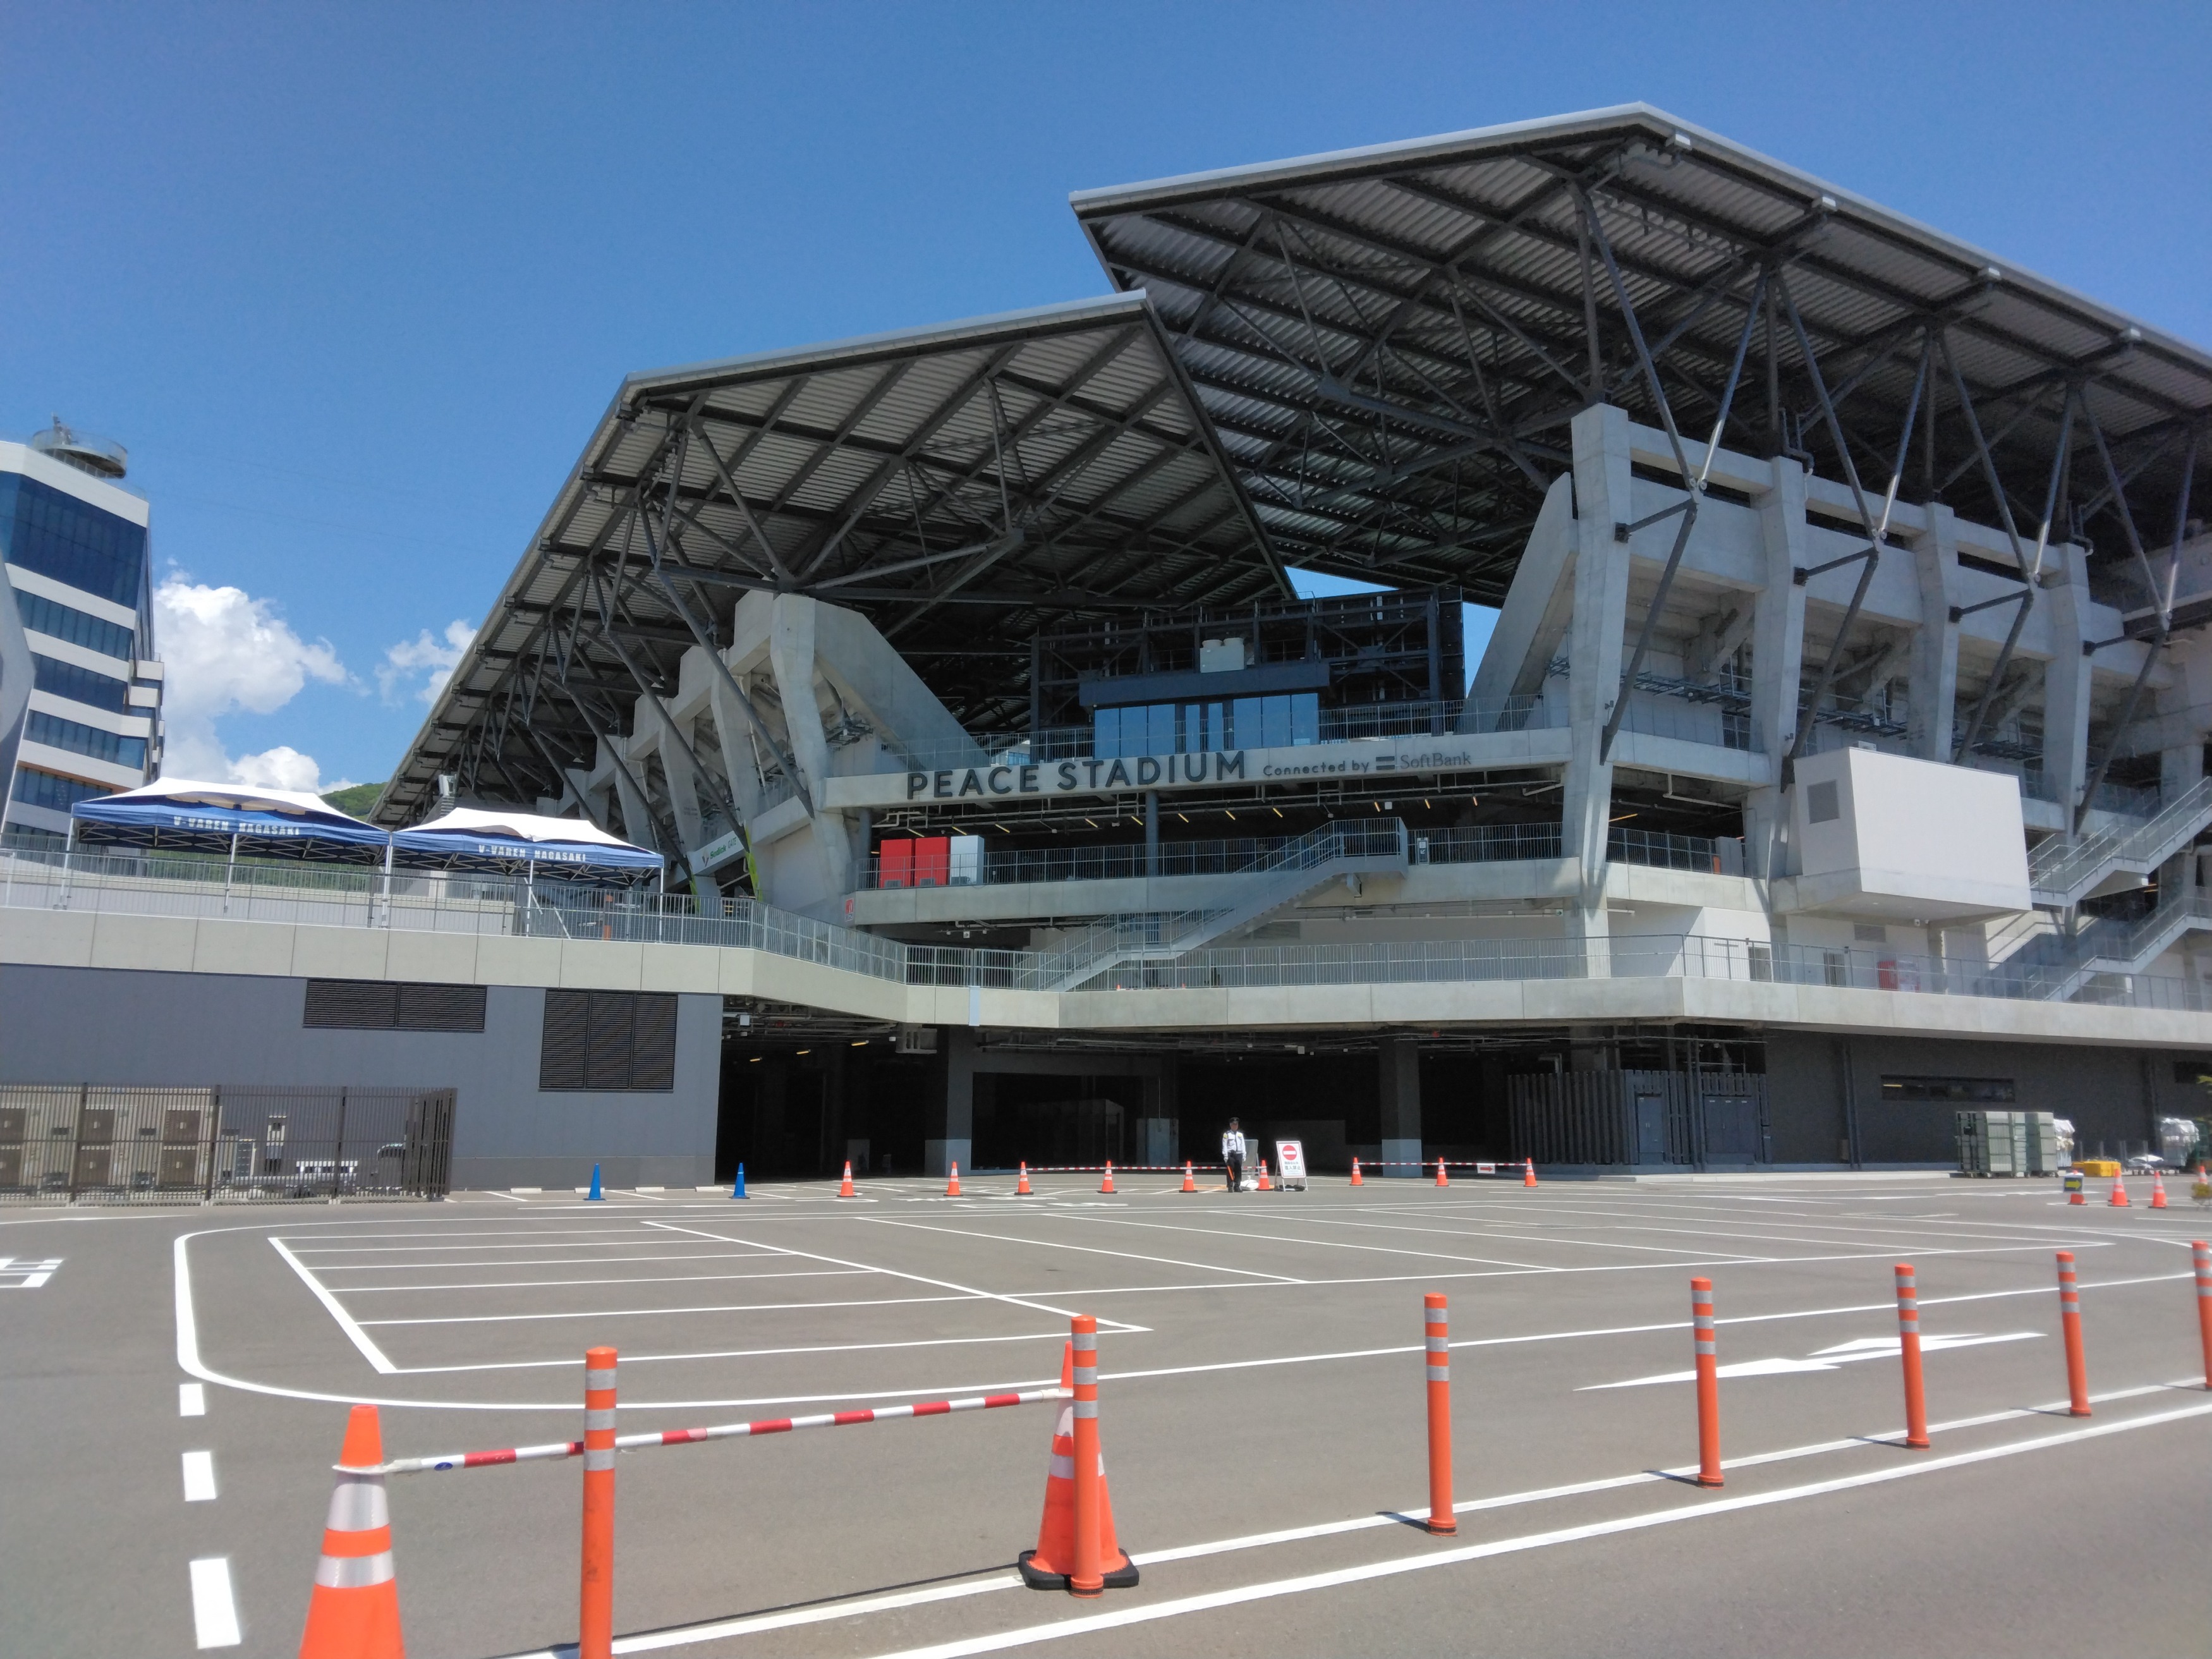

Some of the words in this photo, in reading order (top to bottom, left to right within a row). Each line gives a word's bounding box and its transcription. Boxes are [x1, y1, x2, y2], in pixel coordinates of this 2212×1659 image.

[907, 765, 1039, 799] PEACE
[1057, 751, 1244, 790] STADIUM
[1263, 760, 1346, 776] Connected
[1352, 760, 1369, 773] by
[1400, 751, 1471, 769] SoftBank
[174, 816, 229, 831] V-VAREN
[239, 822, 300, 836] NAGASAKI
[478, 844, 526, 858] V-VAREN
[534, 850, 586, 862] NAGASAKI
